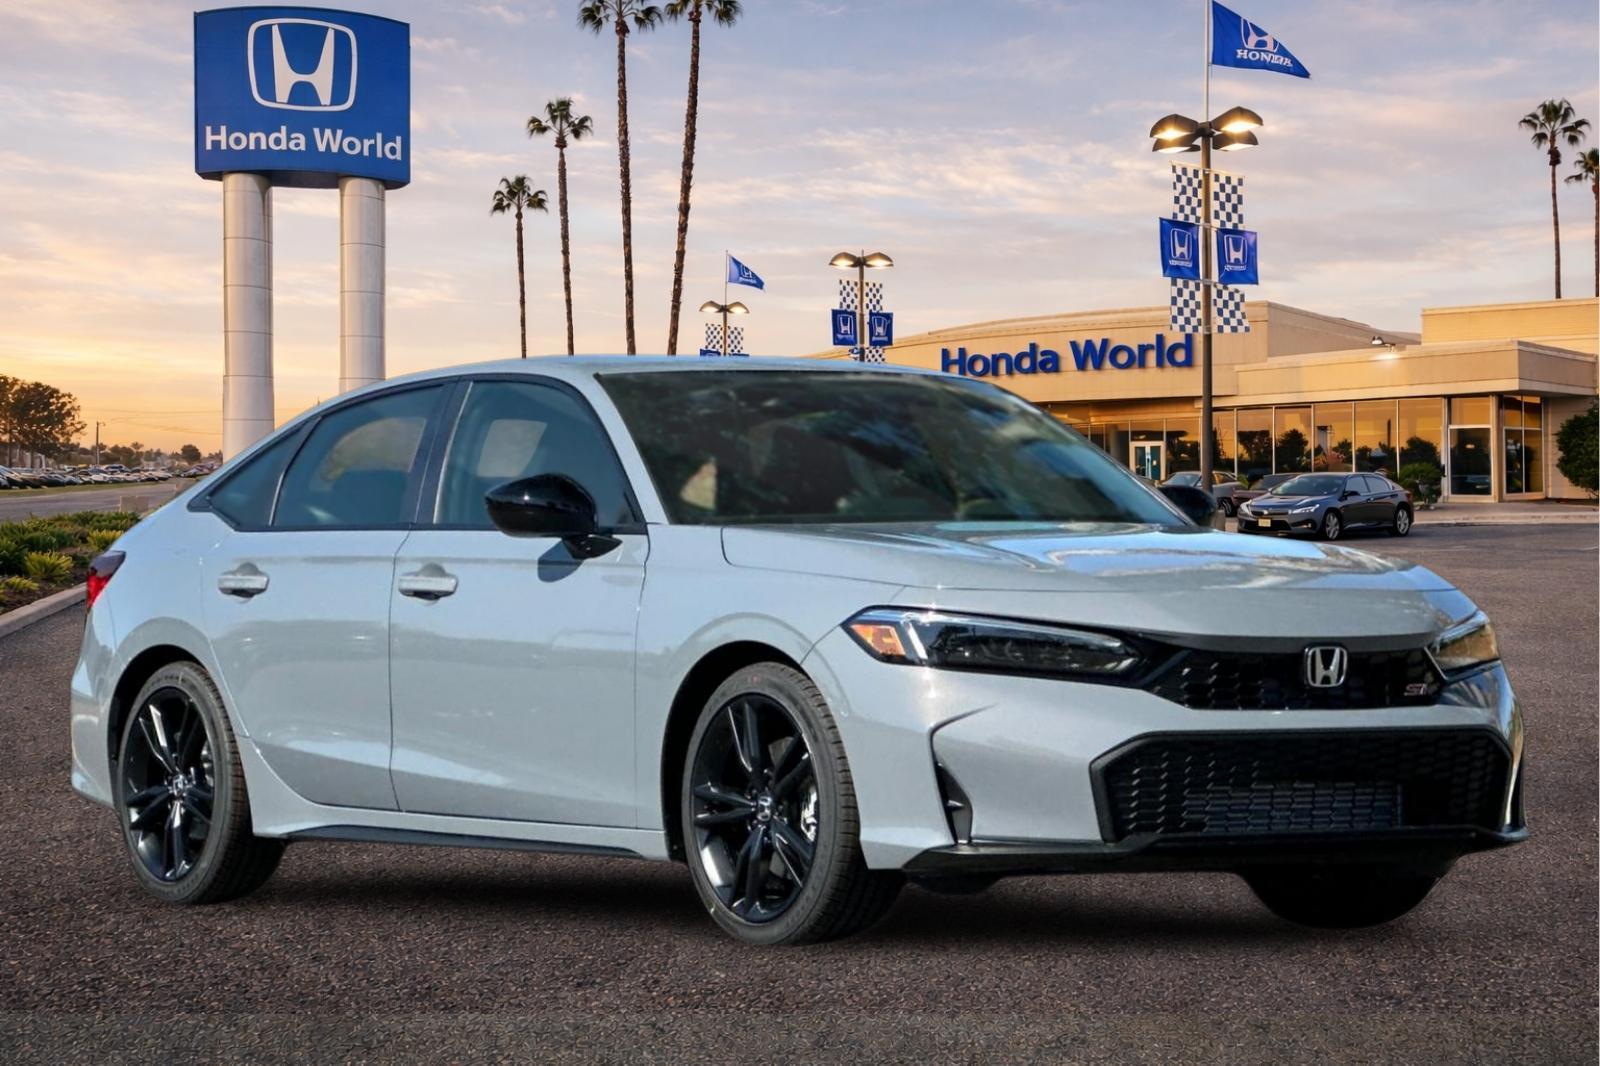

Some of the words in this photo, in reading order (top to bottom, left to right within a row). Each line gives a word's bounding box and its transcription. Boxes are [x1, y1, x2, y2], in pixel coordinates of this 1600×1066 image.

[205, 125, 306, 151] Honda
[312, 127, 402, 161] World
[941, 342, 1061, 377] Honda
[1069, 333, 1194, 371] World
